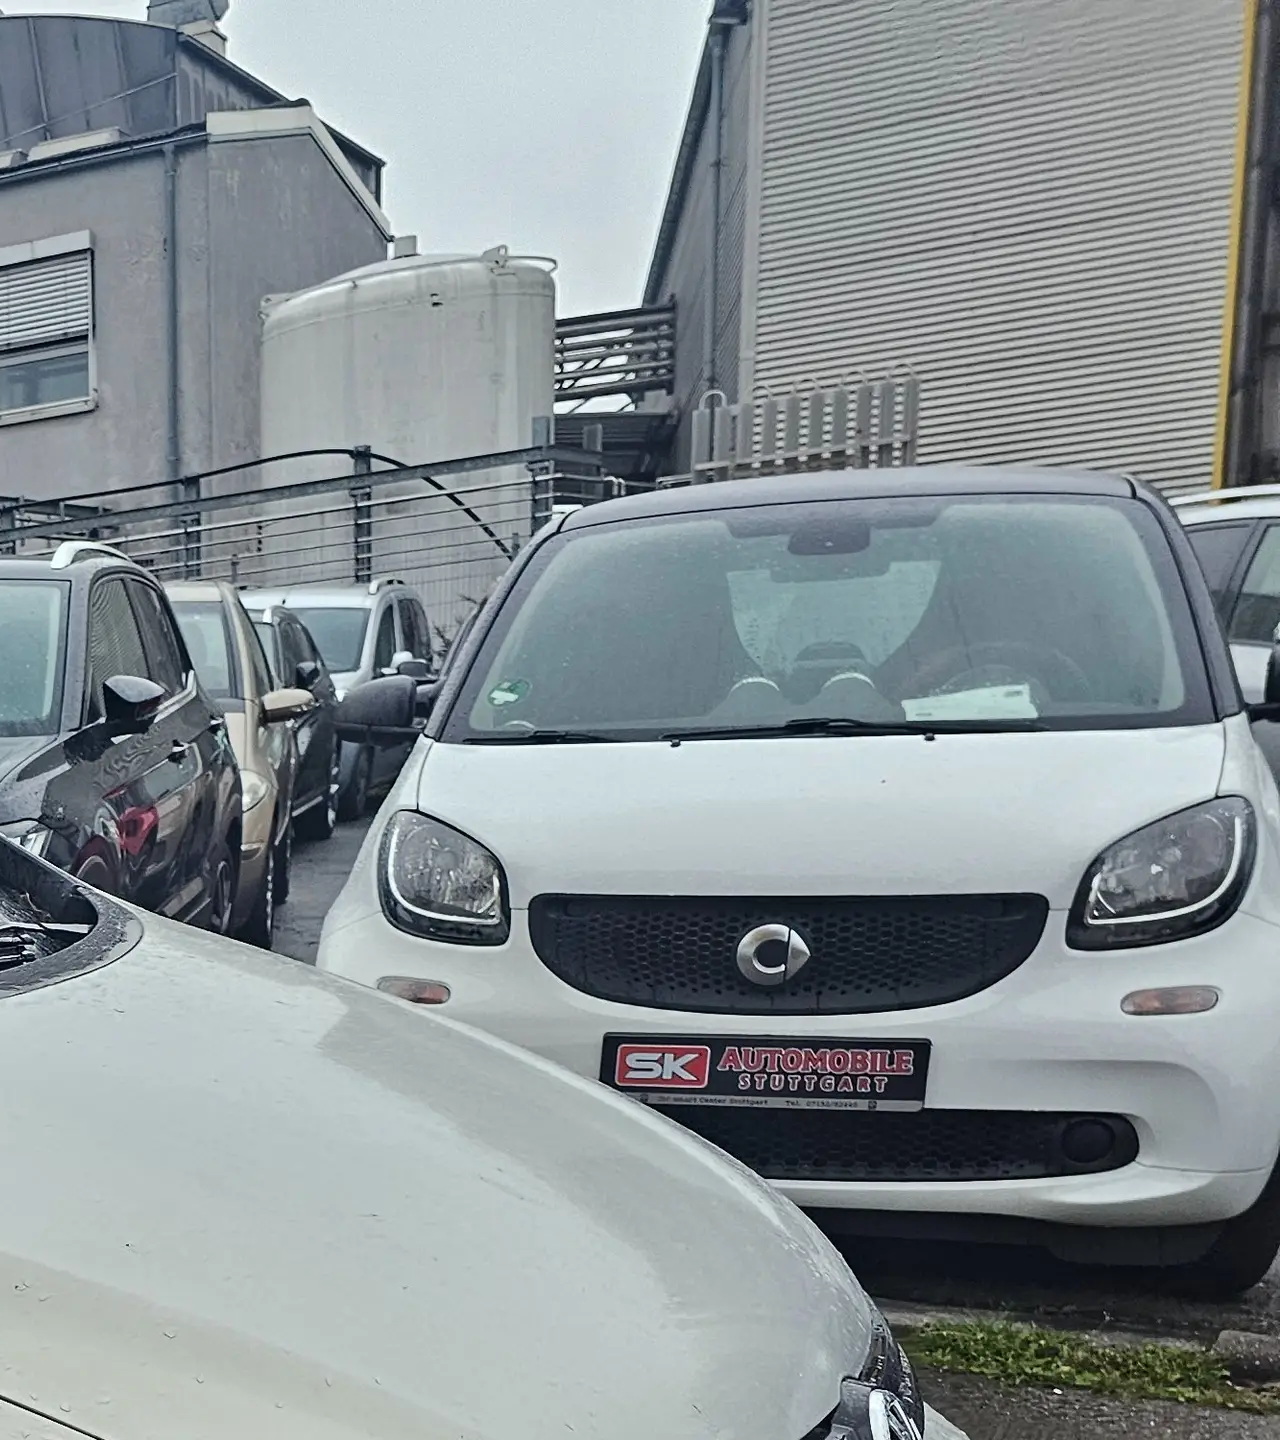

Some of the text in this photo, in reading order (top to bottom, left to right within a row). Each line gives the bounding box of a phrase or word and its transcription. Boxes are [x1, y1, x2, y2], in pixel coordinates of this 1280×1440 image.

[625, 1047, 914, 1080] SK AUTOMOBILE
[739, 1073, 889, 1093] STUTTGART
